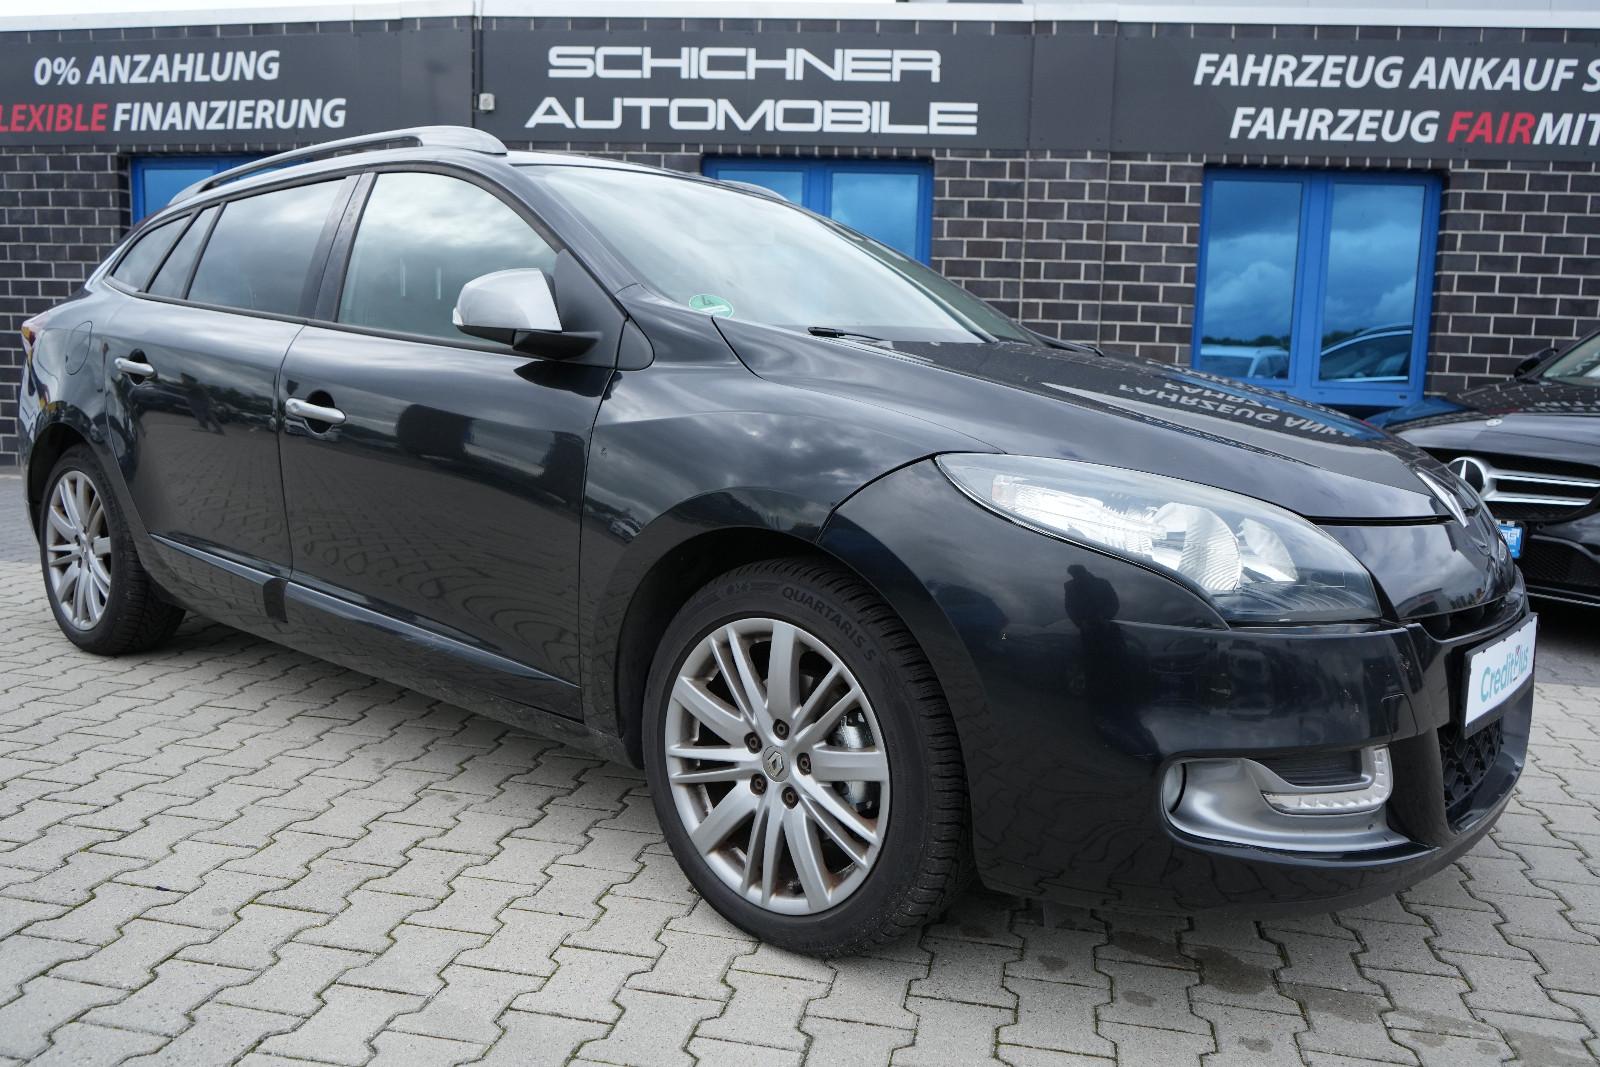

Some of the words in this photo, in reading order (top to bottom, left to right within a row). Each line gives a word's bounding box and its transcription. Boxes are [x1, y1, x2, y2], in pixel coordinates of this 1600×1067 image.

[34, 57, 81, 85] 0%
[86, 50, 280, 84] ANZAHLUNG
[548, 46, 941, 82] SCHICHNER
[1193, 53, 1403, 88] FAHRZEUG
[1409, 56, 1578, 91] ANKAUF
[113, 98, 346, 131] FINANZIERUNG
[525, 97, 978, 135] AUTOMOBILE
[1229, 107, 1440, 143] FAHRZEUG
[782, 586, 867, 649] QUARTARIS
